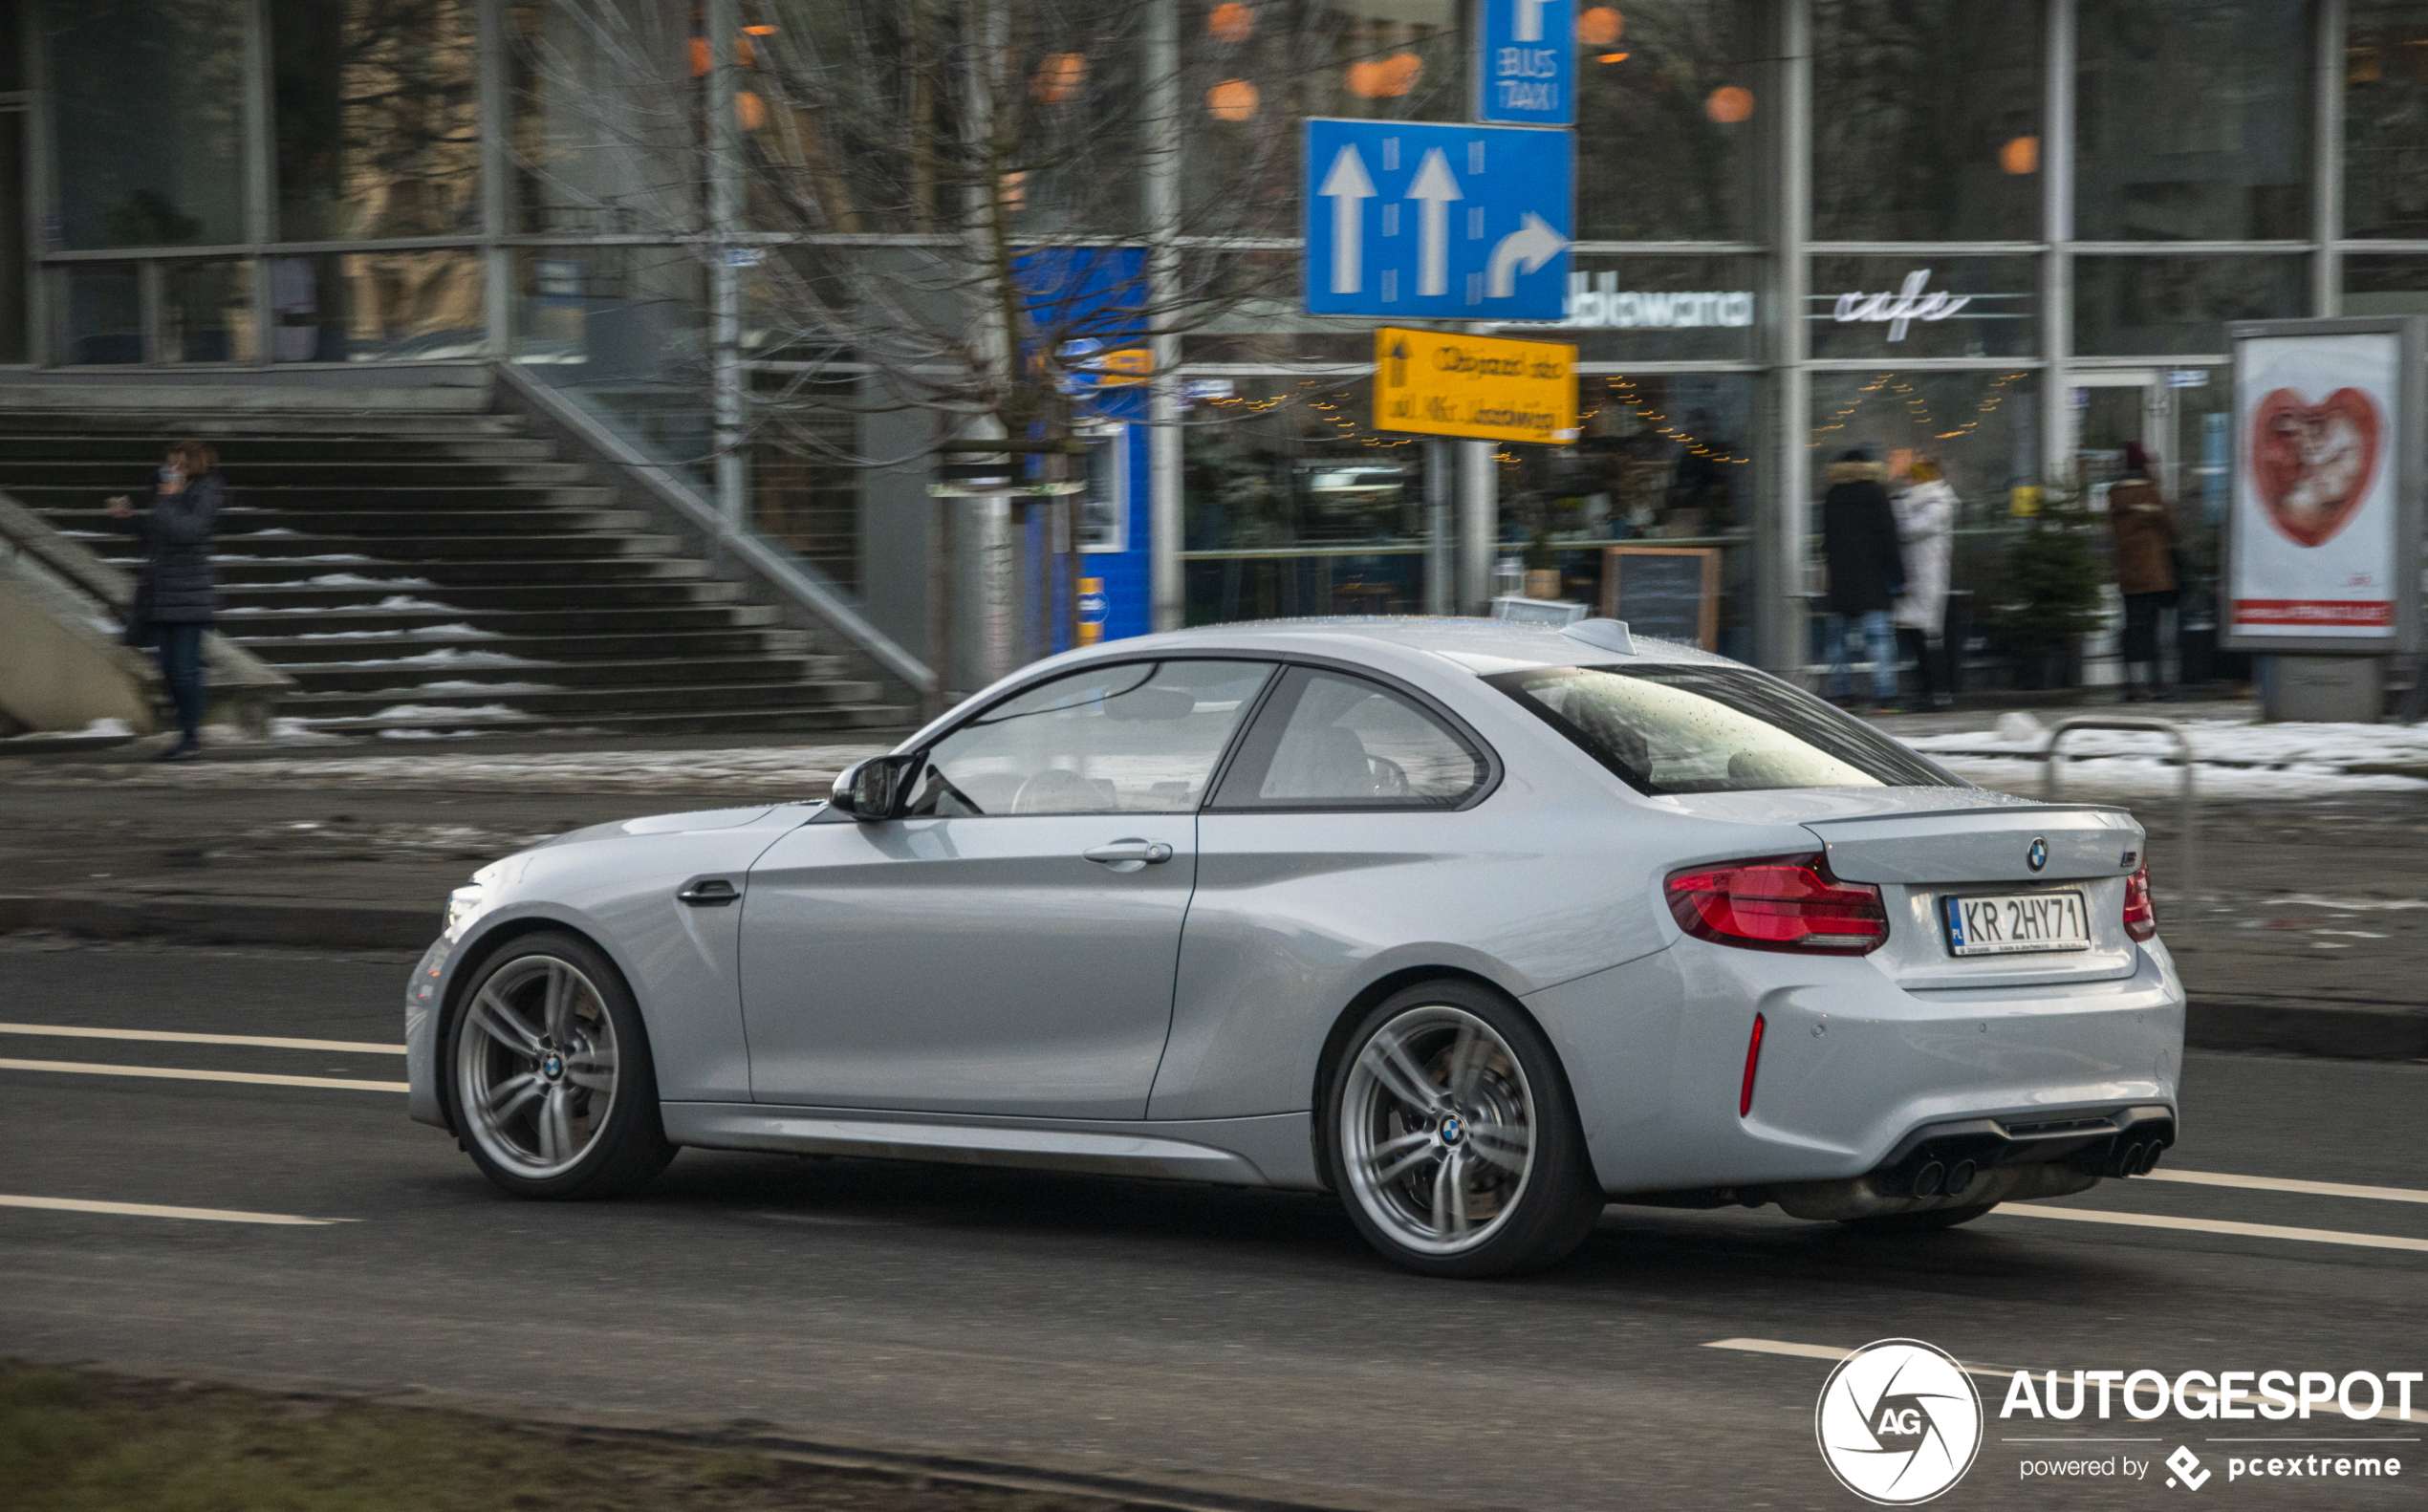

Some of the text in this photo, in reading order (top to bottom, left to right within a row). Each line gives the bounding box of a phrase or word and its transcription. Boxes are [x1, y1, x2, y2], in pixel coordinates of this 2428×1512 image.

[1496, 47, 1557, 78] BUS
[1495, 80, 1559, 110] TAXI
[1833, 269, 1971, 341] cafe
[1952, 928, 1962, 940] PL
[1965, 897, 2079, 942] KR 2HY71
